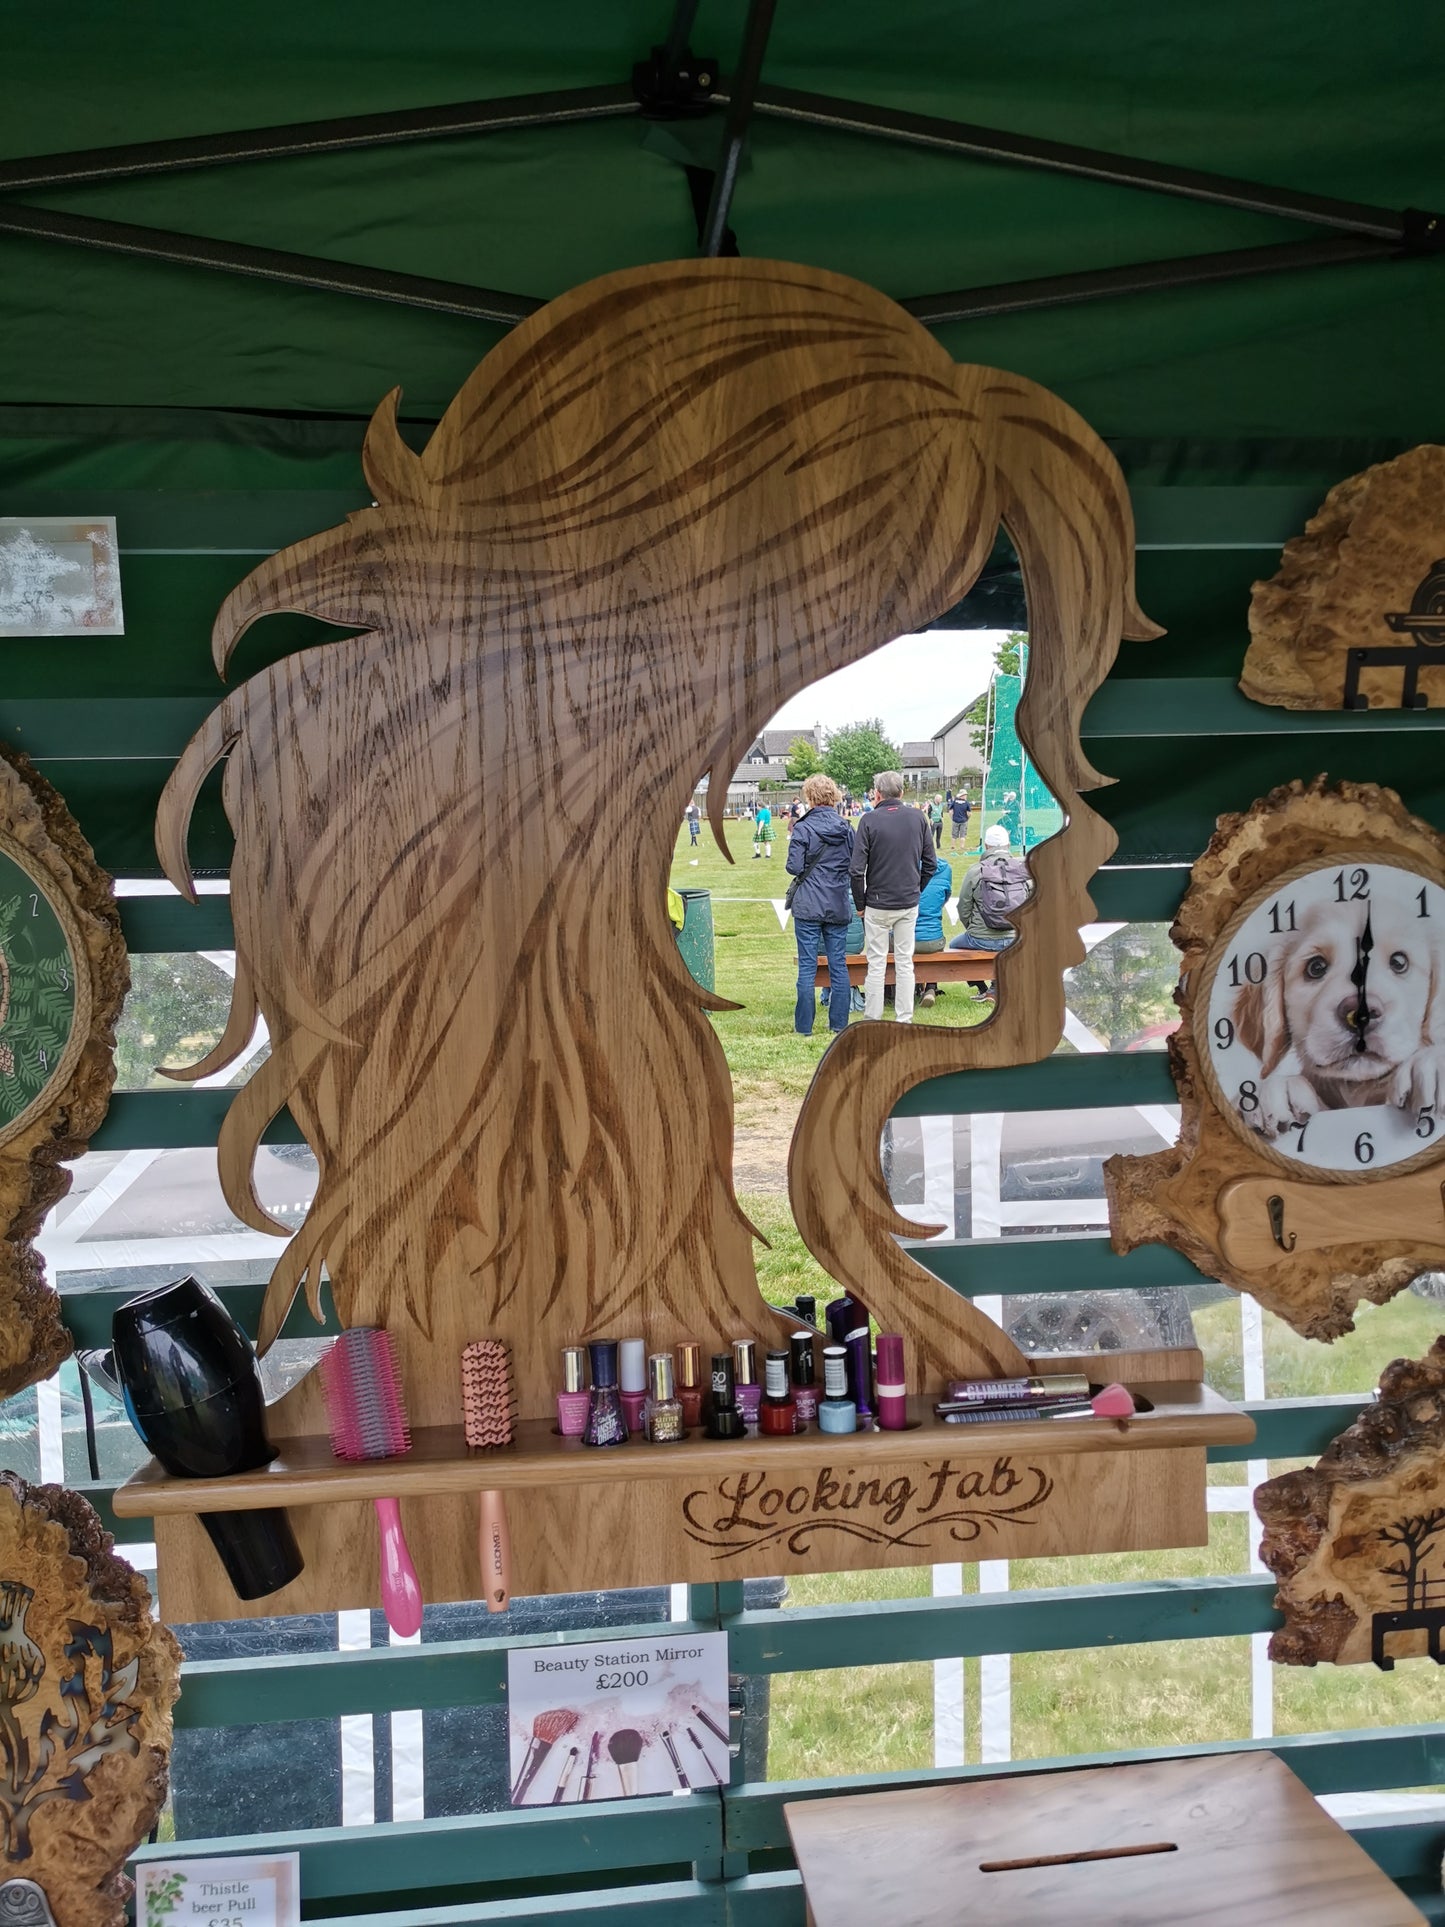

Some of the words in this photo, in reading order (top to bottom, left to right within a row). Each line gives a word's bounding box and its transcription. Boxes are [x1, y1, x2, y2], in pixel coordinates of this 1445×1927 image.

[1333, 869, 1371, 902] 12
[29, 893, 39, 917] 2
[1267, 901, 1300, 934] 11
[1416, 886, 1431, 918] 1
[59, 968, 69, 992] 3
[1227, 952, 1268, 987] 10
[1214, 1018, 1235, 1050] 9
[39, 1048, 48, 1071] 4
[1239, 1080, 1260, 1112] 8
[1416, 1104, 1435, 1138] 5
[1290, 1122, 1309, 1153] 7
[1355, 1132, 1375, 1164] 6
[966, 1383, 1025, 1400] GLIMMER
[713, 1467, 918, 1532] Looking
[534, 1658, 589, 1673] Beauty
[594, 1652, 650, 1667] Station
[655, 1646, 705, 1662] Mirror
[596, 1670, 649, 1690] £200
[200, 1880, 250, 1897] Thistle
[192, 1900, 223, 1913] beer
[228, 1898, 257, 1912] Pull
